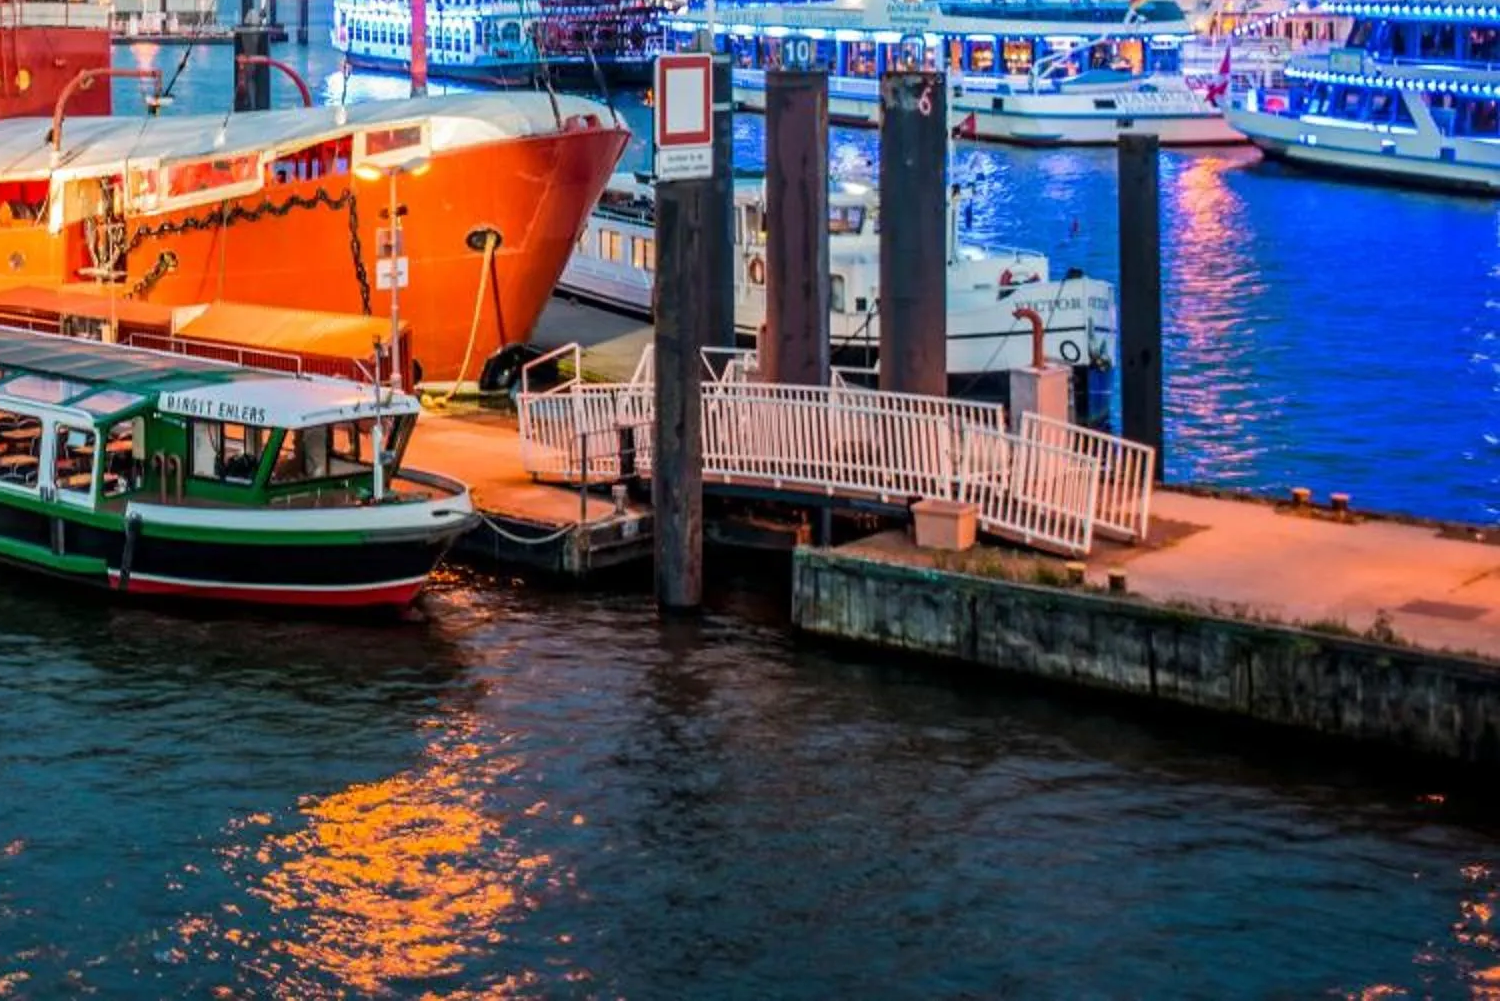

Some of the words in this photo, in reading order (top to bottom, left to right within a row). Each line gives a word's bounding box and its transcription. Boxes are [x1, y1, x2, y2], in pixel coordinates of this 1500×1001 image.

[785, 39, 809, 62] 10
[918, 86, 932, 116] 6
[167, 394, 213, 416] BIRGIT
[219, 402, 266, 424] EHLERS
